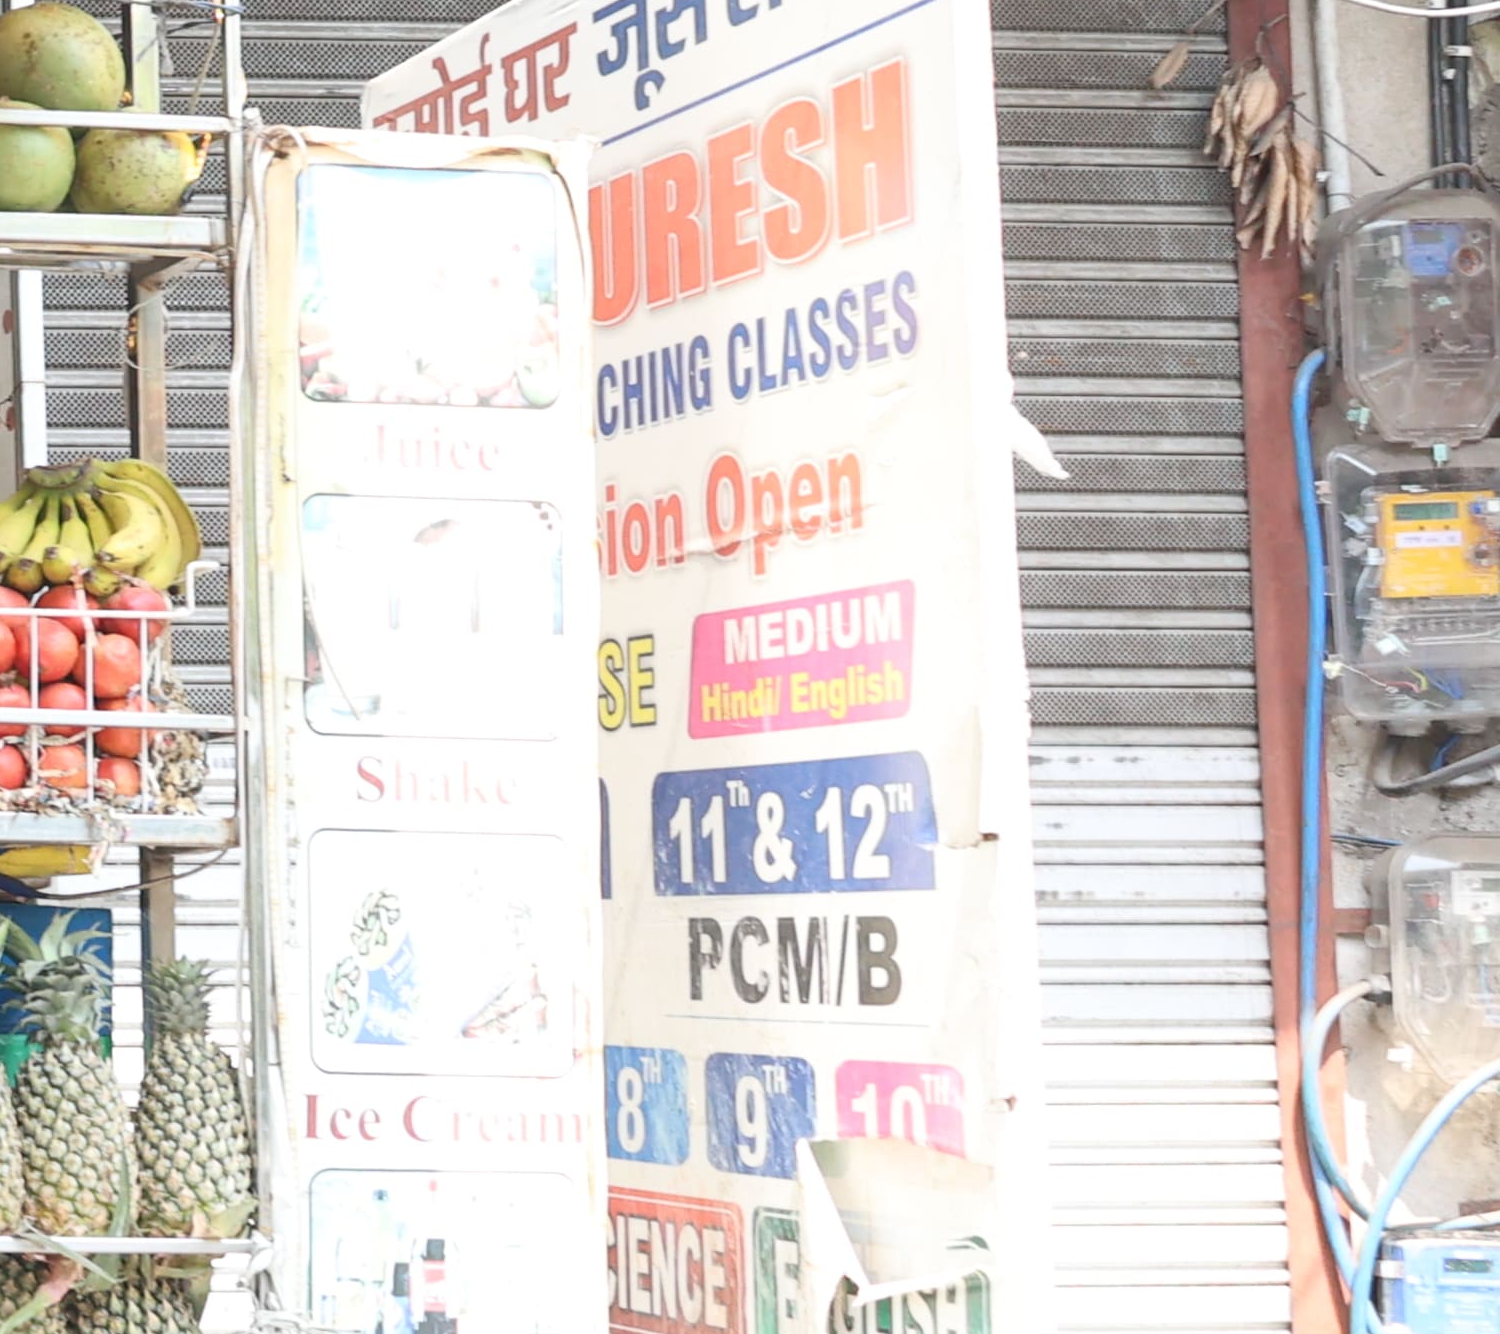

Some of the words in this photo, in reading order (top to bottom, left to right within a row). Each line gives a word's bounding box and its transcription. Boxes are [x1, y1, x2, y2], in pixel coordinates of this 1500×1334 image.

[501, 21, 578, 123] घर
[728, 269, 918, 403] CLASSES
[597, 482, 687, 578] ion
[705, 449, 865, 576] Open
[724, 590, 902, 666] MEDIUM
[701, 675, 781, 724] Hindi/
[792, 661, 904, 719] English
[753, 792, 796, 885] &
[687, 913, 903, 1007] PCM/B
[301, 1092, 382, 1142] Ice
